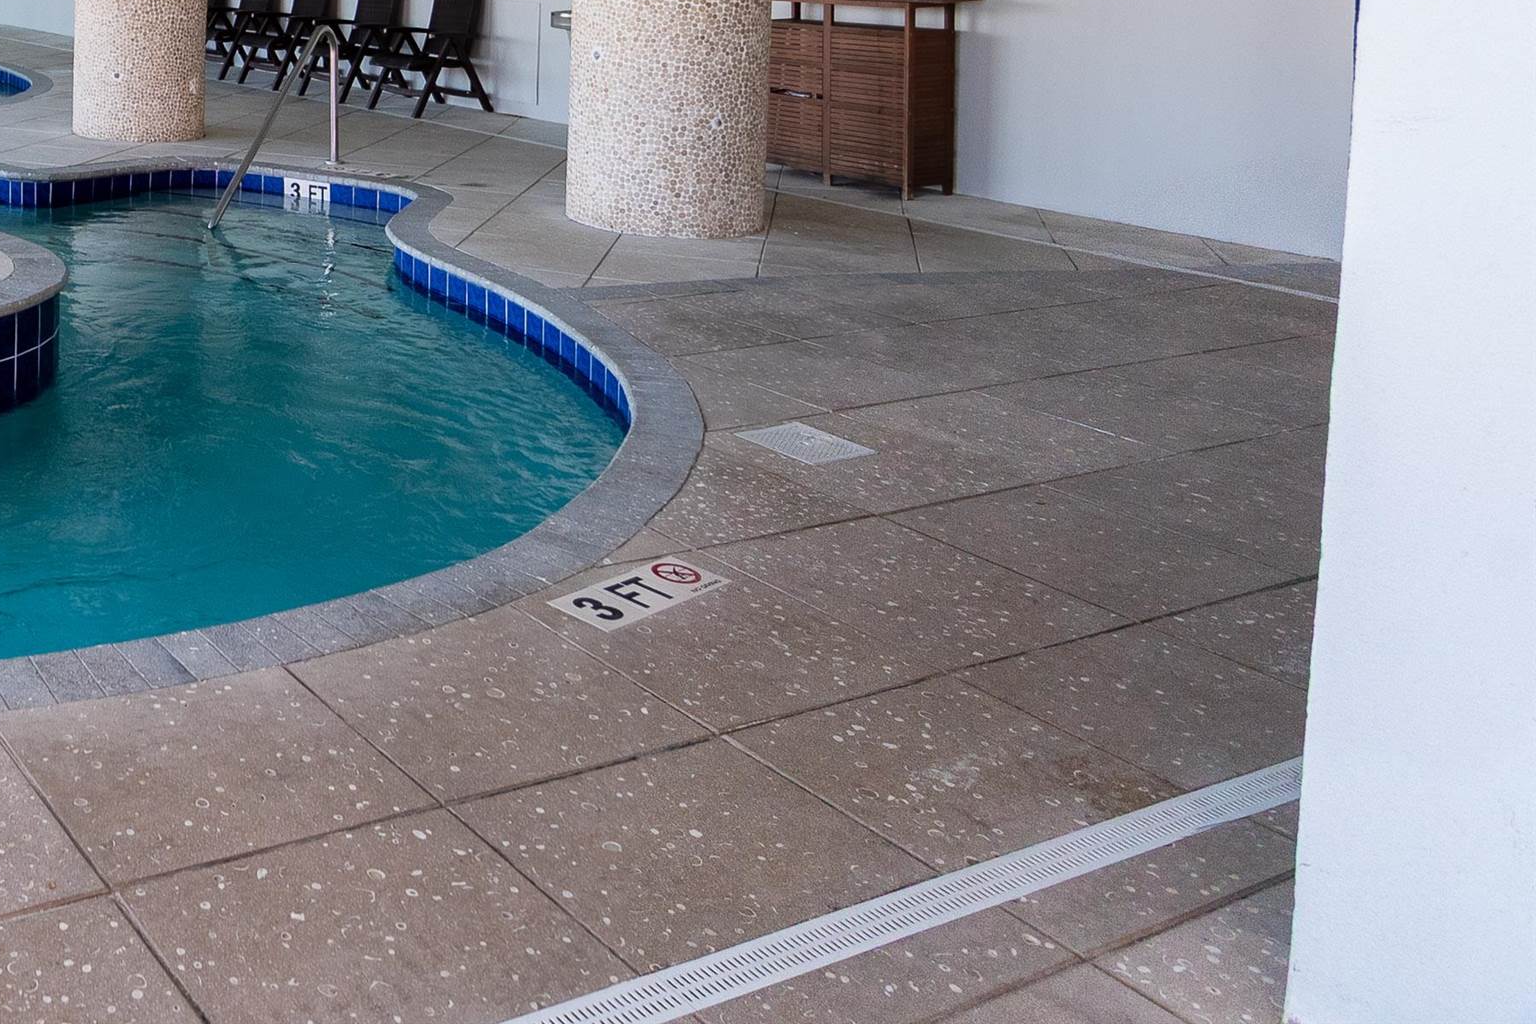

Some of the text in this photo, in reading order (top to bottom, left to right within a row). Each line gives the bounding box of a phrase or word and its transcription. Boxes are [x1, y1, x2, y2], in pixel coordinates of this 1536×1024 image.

[290, 182, 328, 201] 3 FT
[572, 576, 674, 621] 3 FT
